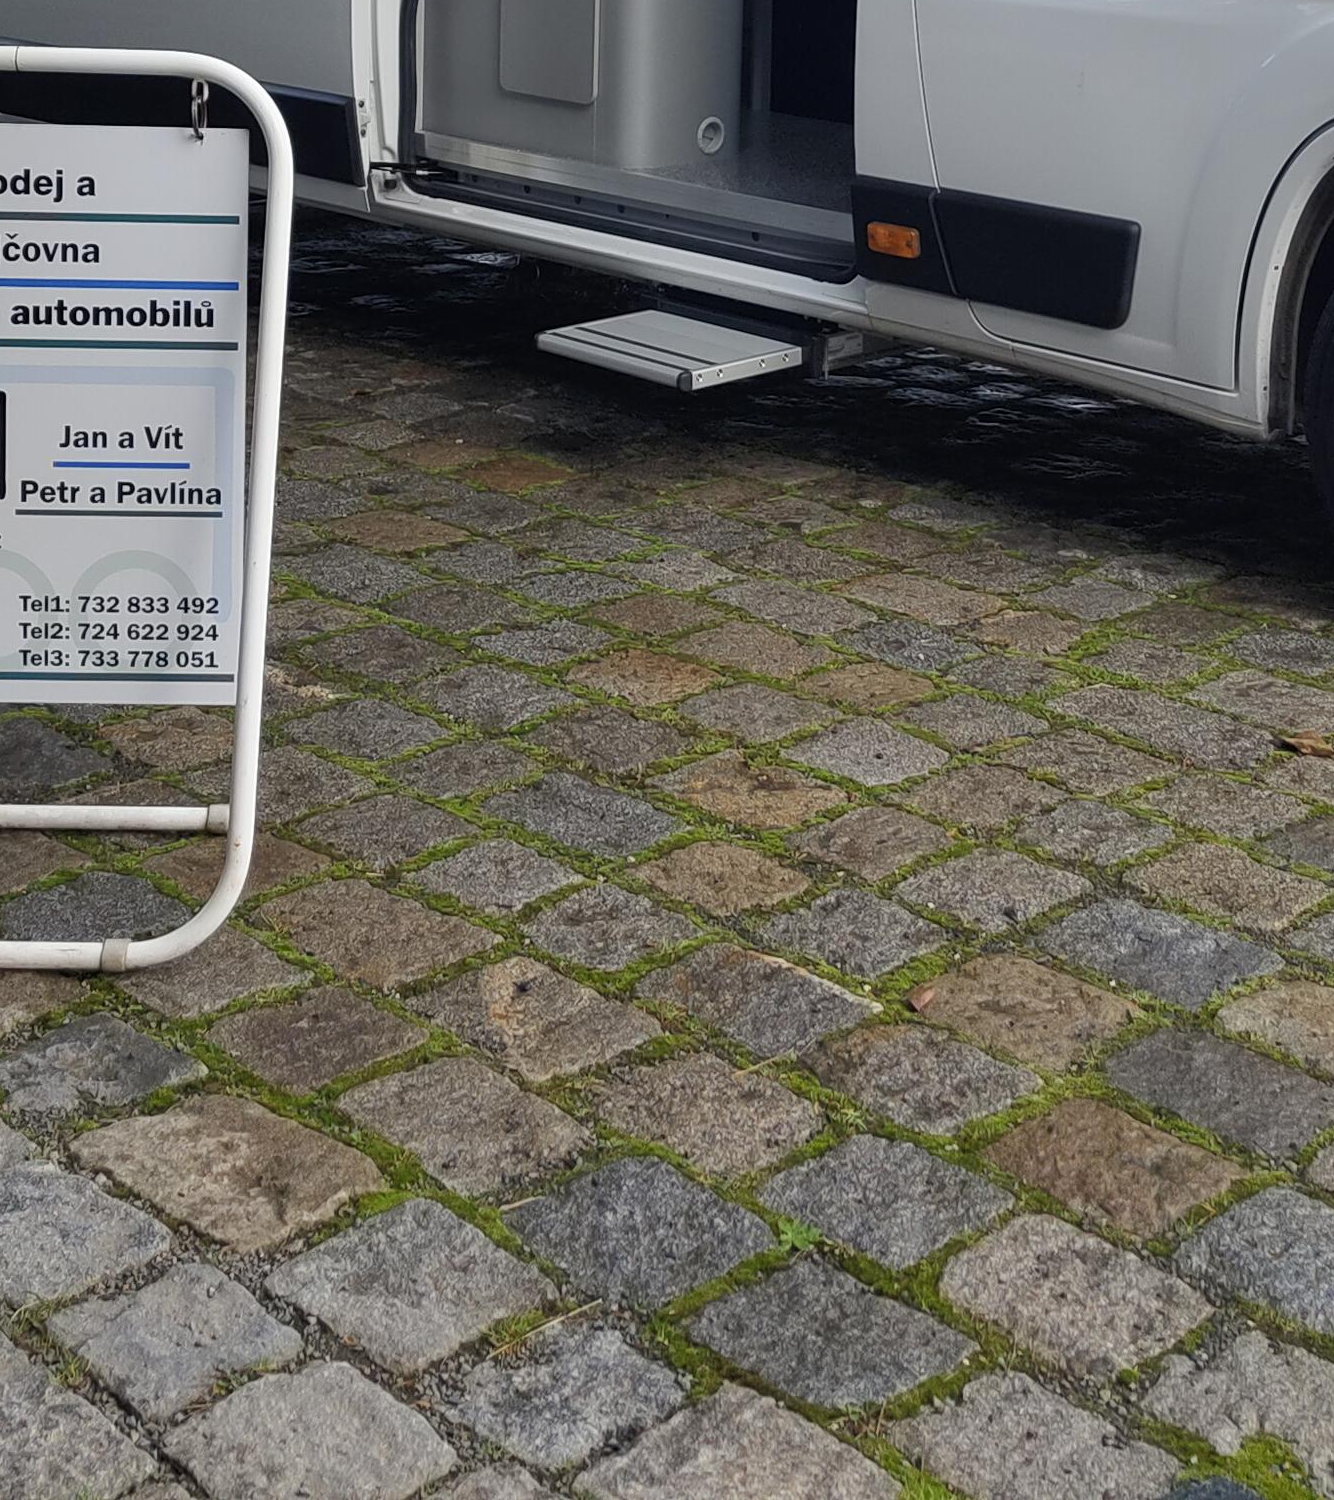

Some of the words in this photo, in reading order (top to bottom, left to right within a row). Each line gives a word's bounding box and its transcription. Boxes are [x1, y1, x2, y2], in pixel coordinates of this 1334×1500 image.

[76, 176, 96, 197] a
[10, 299, 214, 328] automobilů
[59, 425, 108, 449] Jan
[118, 431, 134, 449] a
[144, 424, 184, 450] Vít
[20, 480, 80, 504] Petr
[89, 486, 106, 504] a
[117, 480, 222, 506] Pavlína
[18, 595, 70, 613] Tel1:
[77, 595, 120, 613] 732
[127, 596, 170, 614] 833
[176, 596, 219, 614] 492
[18, 622, 70, 640] Tel2:
[77, 623, 120, 640] 724
[127, 623, 169, 641] 622
[176, 623, 219, 641] 924
[18, 649, 70, 667] Tel3:
[77, 649, 120, 668] 733
[127, 650, 169, 668] 778
[175, 650, 219, 668] 051
